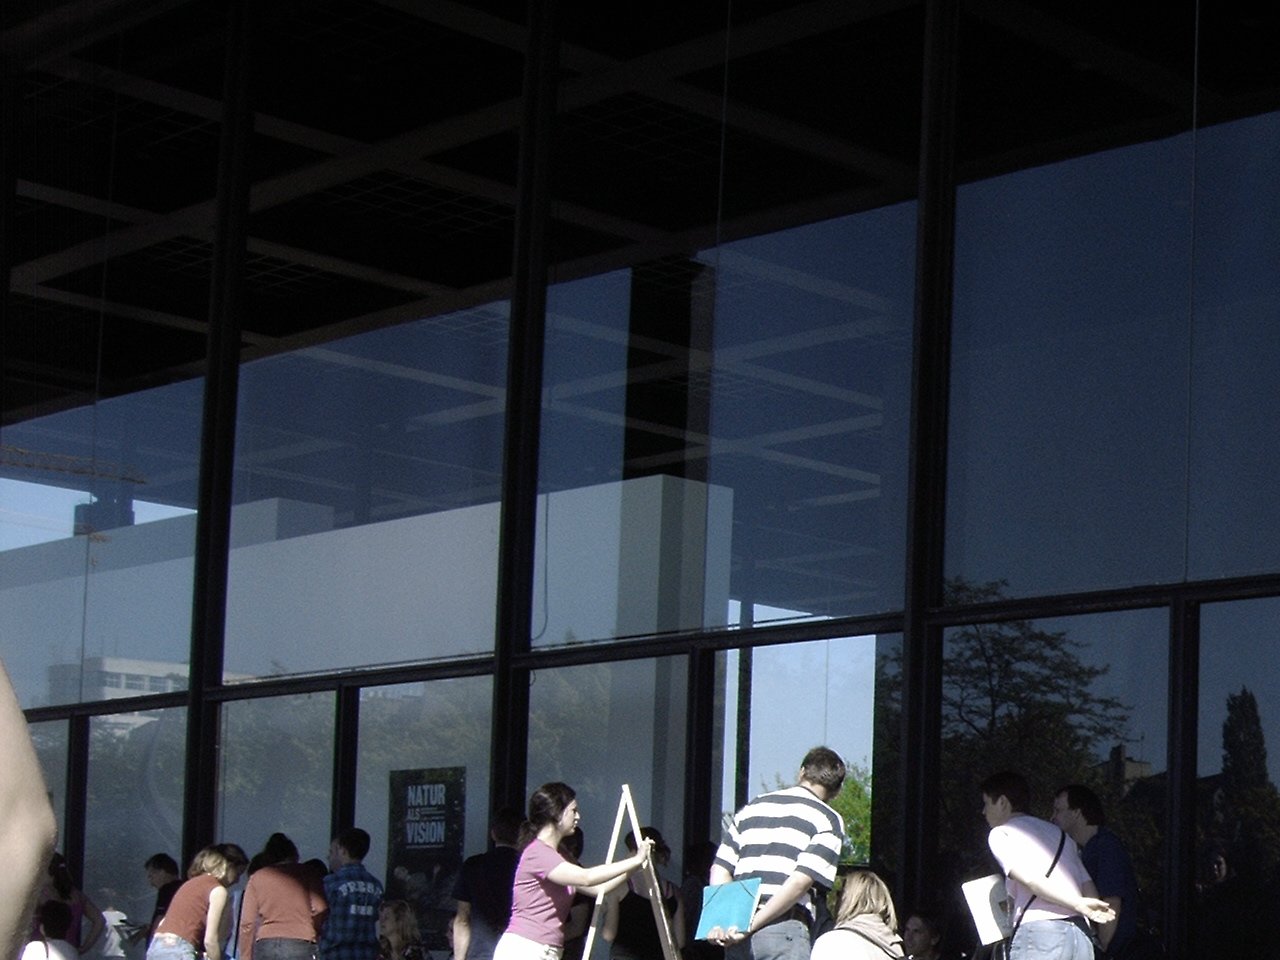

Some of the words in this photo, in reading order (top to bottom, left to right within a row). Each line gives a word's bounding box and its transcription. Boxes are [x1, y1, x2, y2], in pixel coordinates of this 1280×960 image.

[408, 784, 446, 806] NATUR
[407, 808, 420, 820] ALS
[406, 821, 445, 843] VISION
